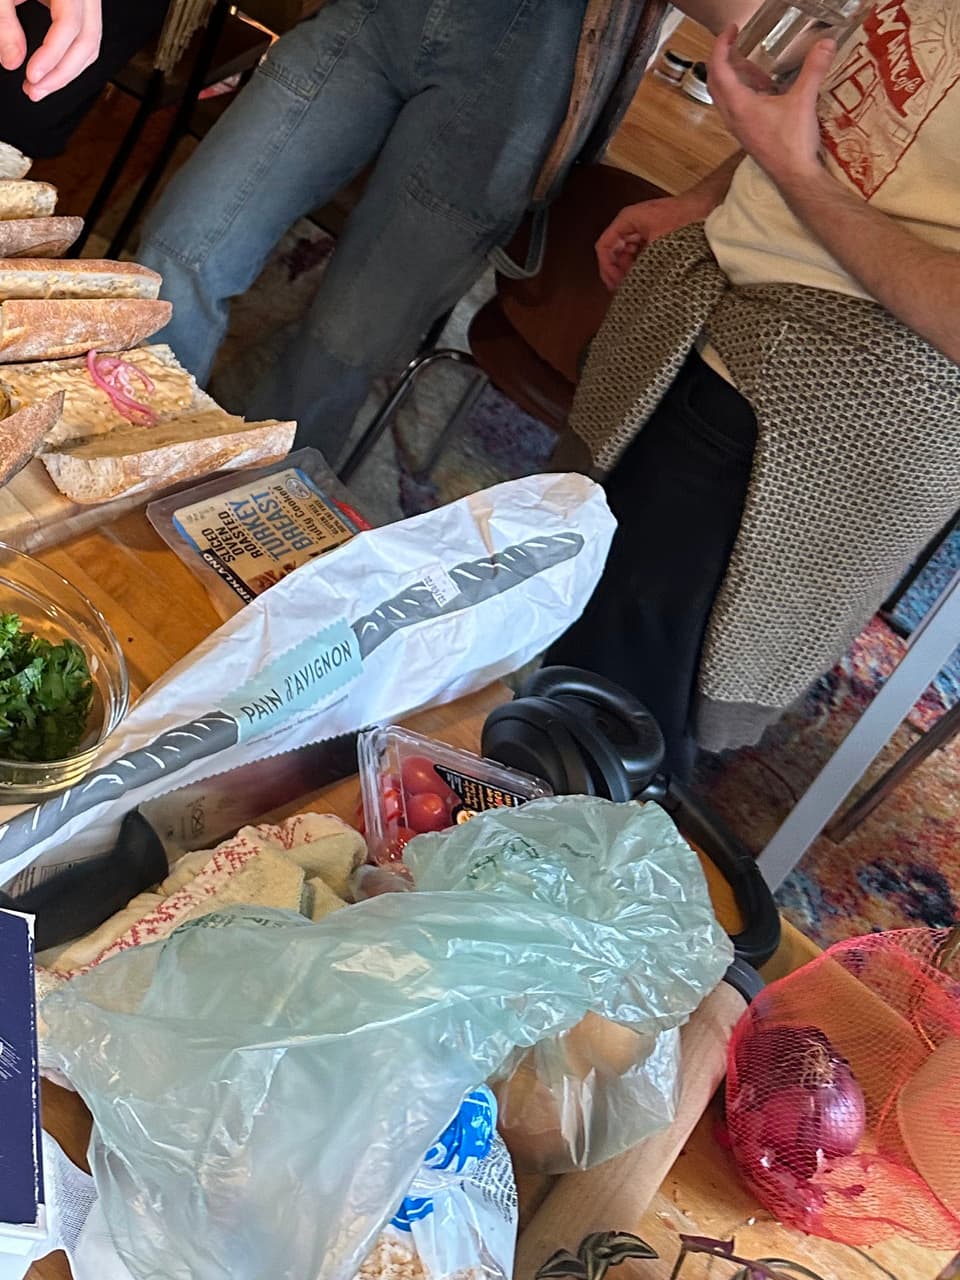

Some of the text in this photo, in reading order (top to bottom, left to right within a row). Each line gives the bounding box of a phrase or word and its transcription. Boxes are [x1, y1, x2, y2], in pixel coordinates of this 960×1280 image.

[218, 510, 264, 559] ROASTED
[229, 499, 291, 561] TURKEY
[249, 491, 314, 551] BREAST
[272, 485, 327, 541] Fully Cooked
[308, 503, 339, 535] GLUTEN FREE
[201, 527, 236, 563] SLICED
[215, 526, 245, 556] OVEN
[240, 688, 284, 725] PAIN
[284, 640, 353, 702] d'AVIGNON
